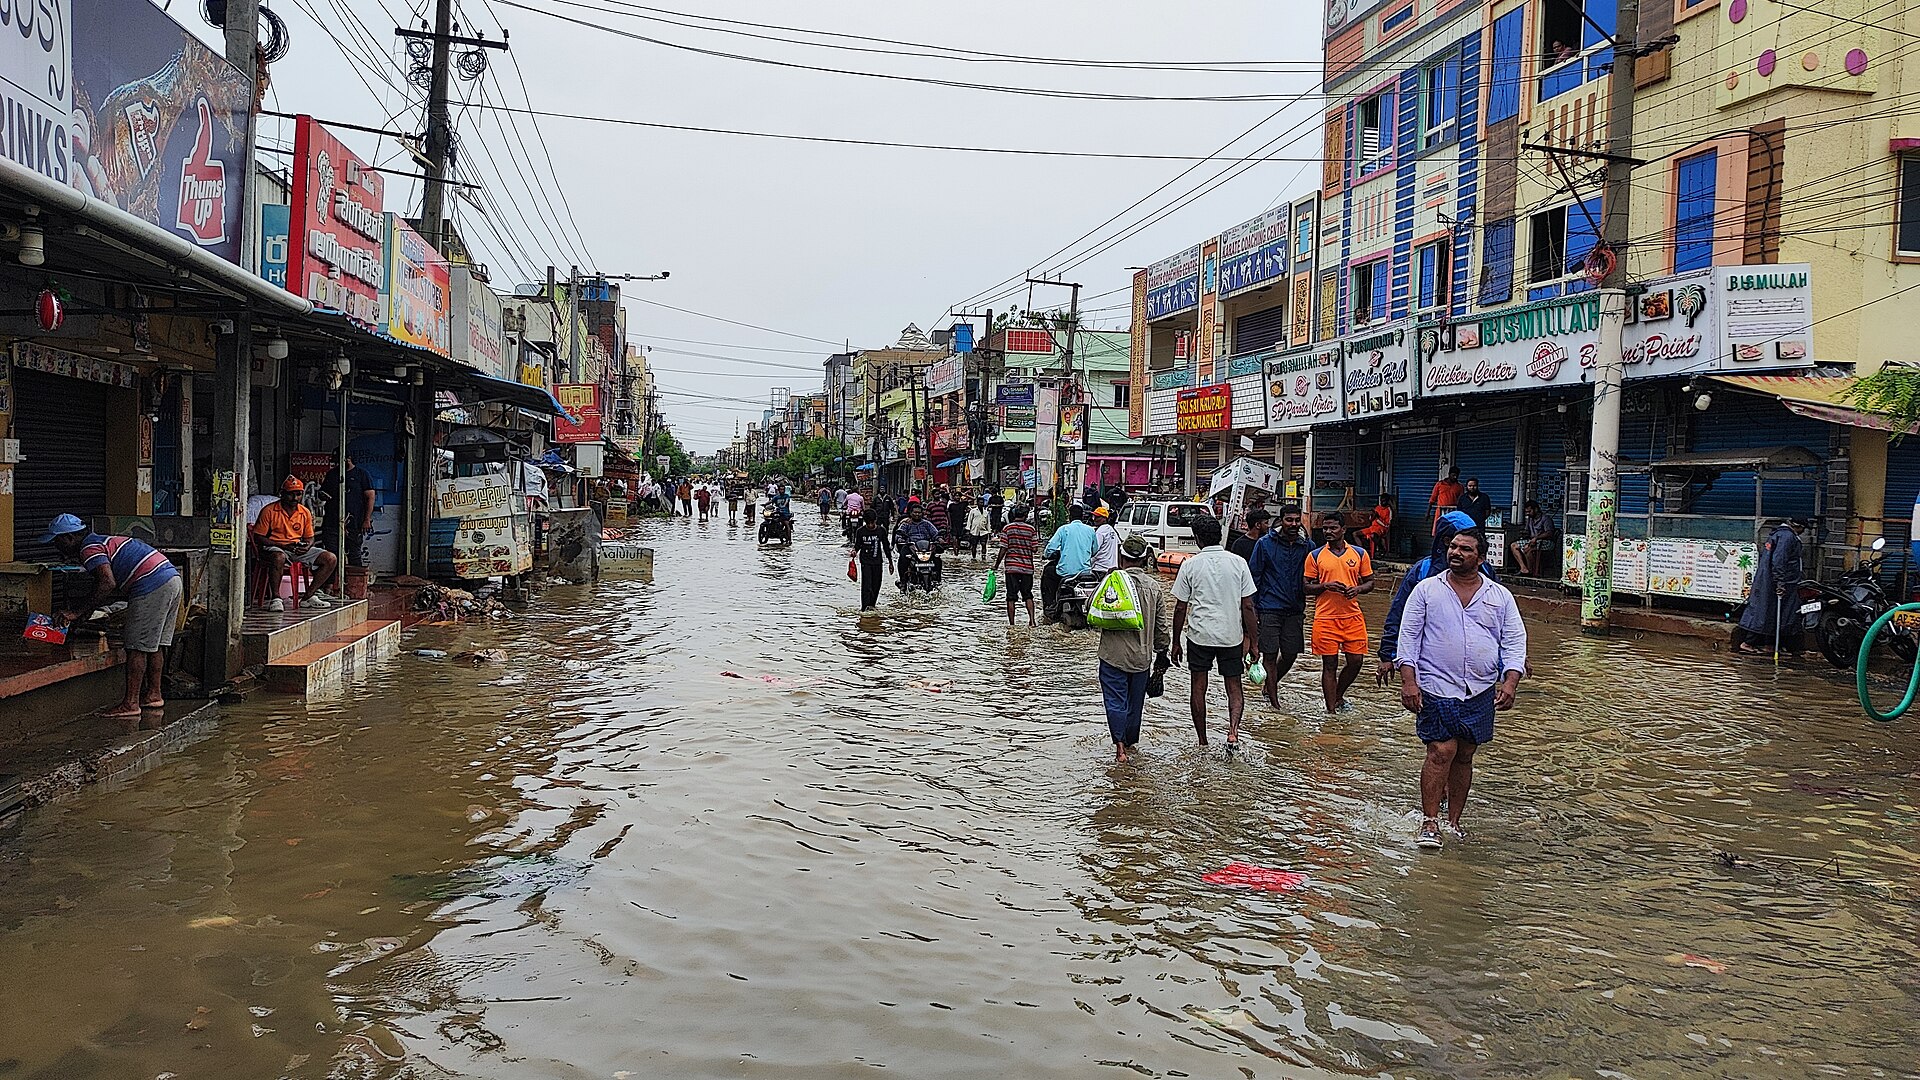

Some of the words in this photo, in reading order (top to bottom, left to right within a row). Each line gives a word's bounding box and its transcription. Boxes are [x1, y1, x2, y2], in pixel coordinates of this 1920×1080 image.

[183, 175, 223, 206] Thums
[420, 275, 443, 313] STORES
[1727, 272, 1807, 290] BISMILLAH
[1482, 300, 1600, 346] BISMILLAH
[1354, 332, 1395, 353] BISMILLAH
[1646, 335, 1698, 362] Point
[1280, 354, 1320, 374] BISMILLAH
[1426, 363, 1472, 391] Chicken
[1473, 358, 1518, 387] Center
[1530, 349, 1562, 374] QUALITY
[1347, 369, 1382, 394] Chicken
[1383, 359, 1408, 384] Hub
[1311, 394, 1337, 417] Center
